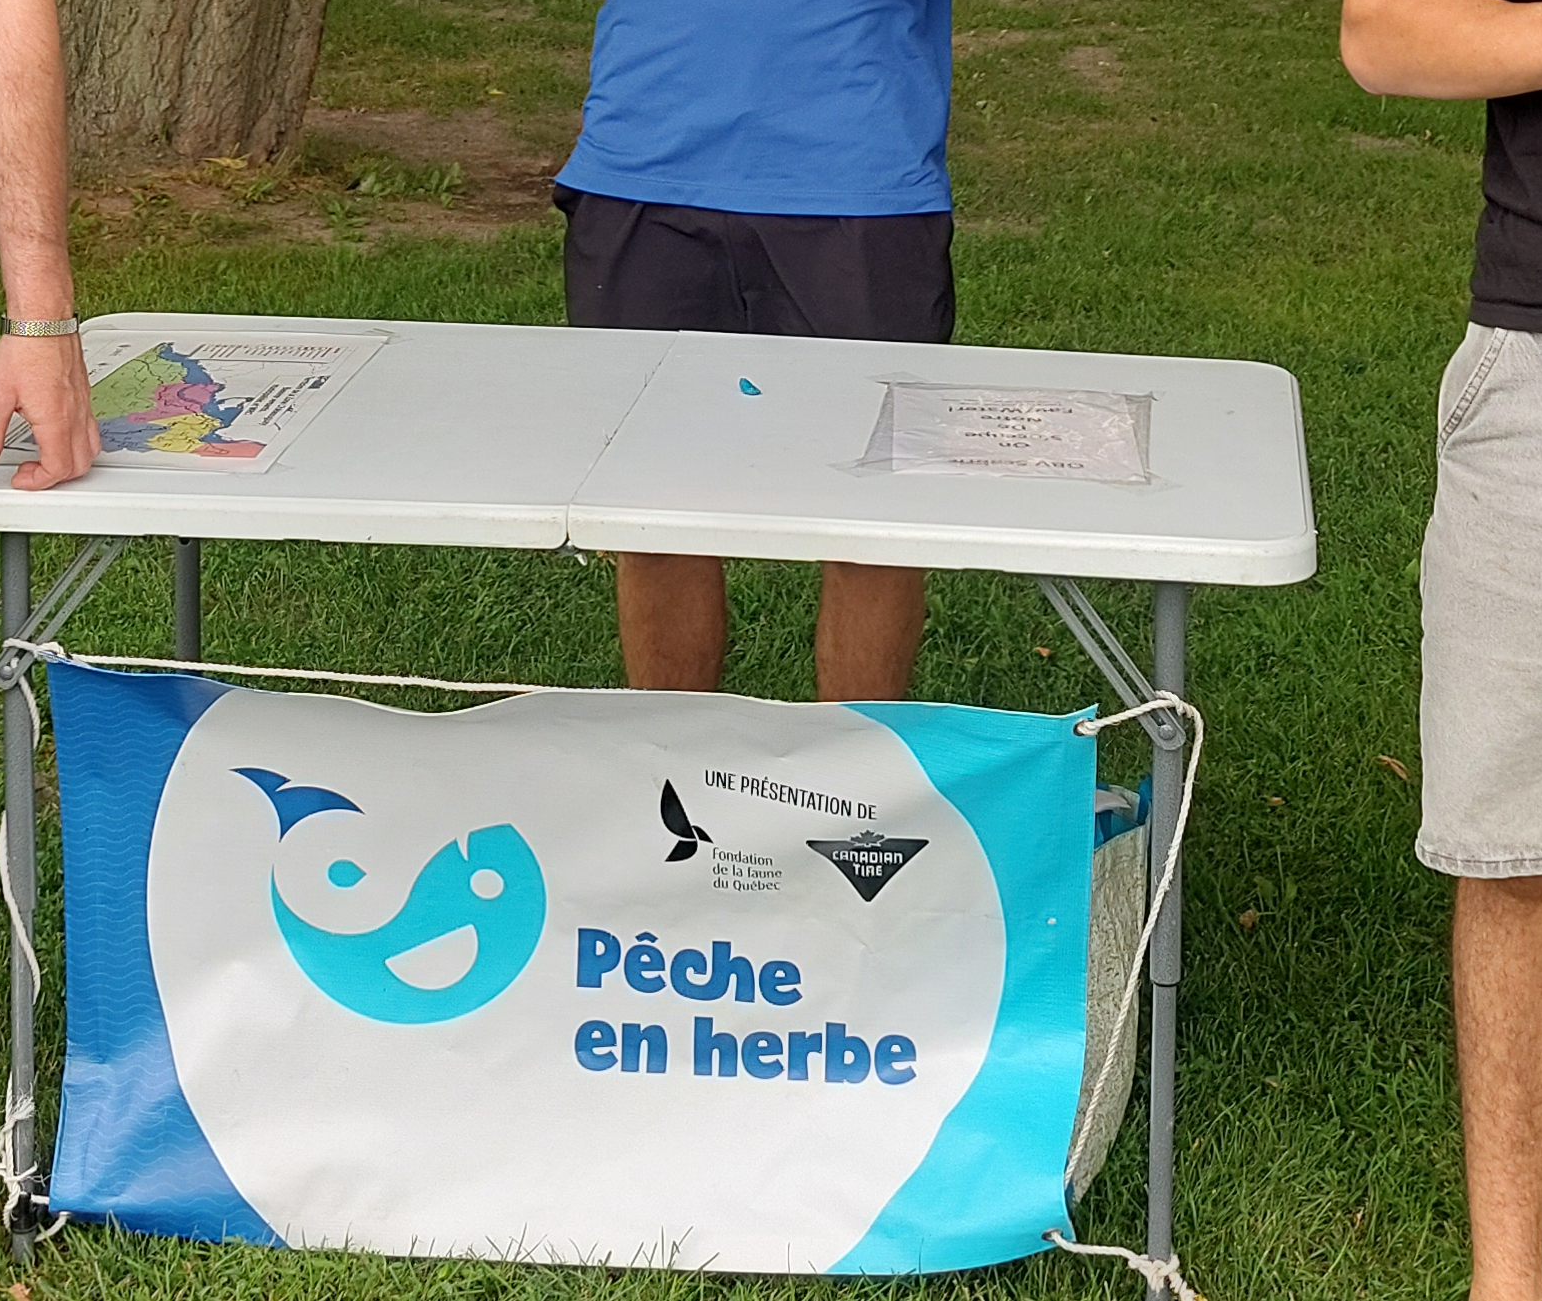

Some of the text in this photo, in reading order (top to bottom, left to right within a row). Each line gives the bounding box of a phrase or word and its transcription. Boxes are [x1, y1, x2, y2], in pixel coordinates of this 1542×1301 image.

[704, 769, 877, 820] UNE PRÉSENTATION DE
[712, 847, 773, 867] Fondation
[832, 849, 903, 865] CANADIAN
[712, 863, 782, 879] de la faune
[852, 863, 883, 877] TIRE
[713, 877, 781, 892] du Québec
[576, 928, 803, 1006] Pêche
[574, 1016, 918, 1086] en herbe
